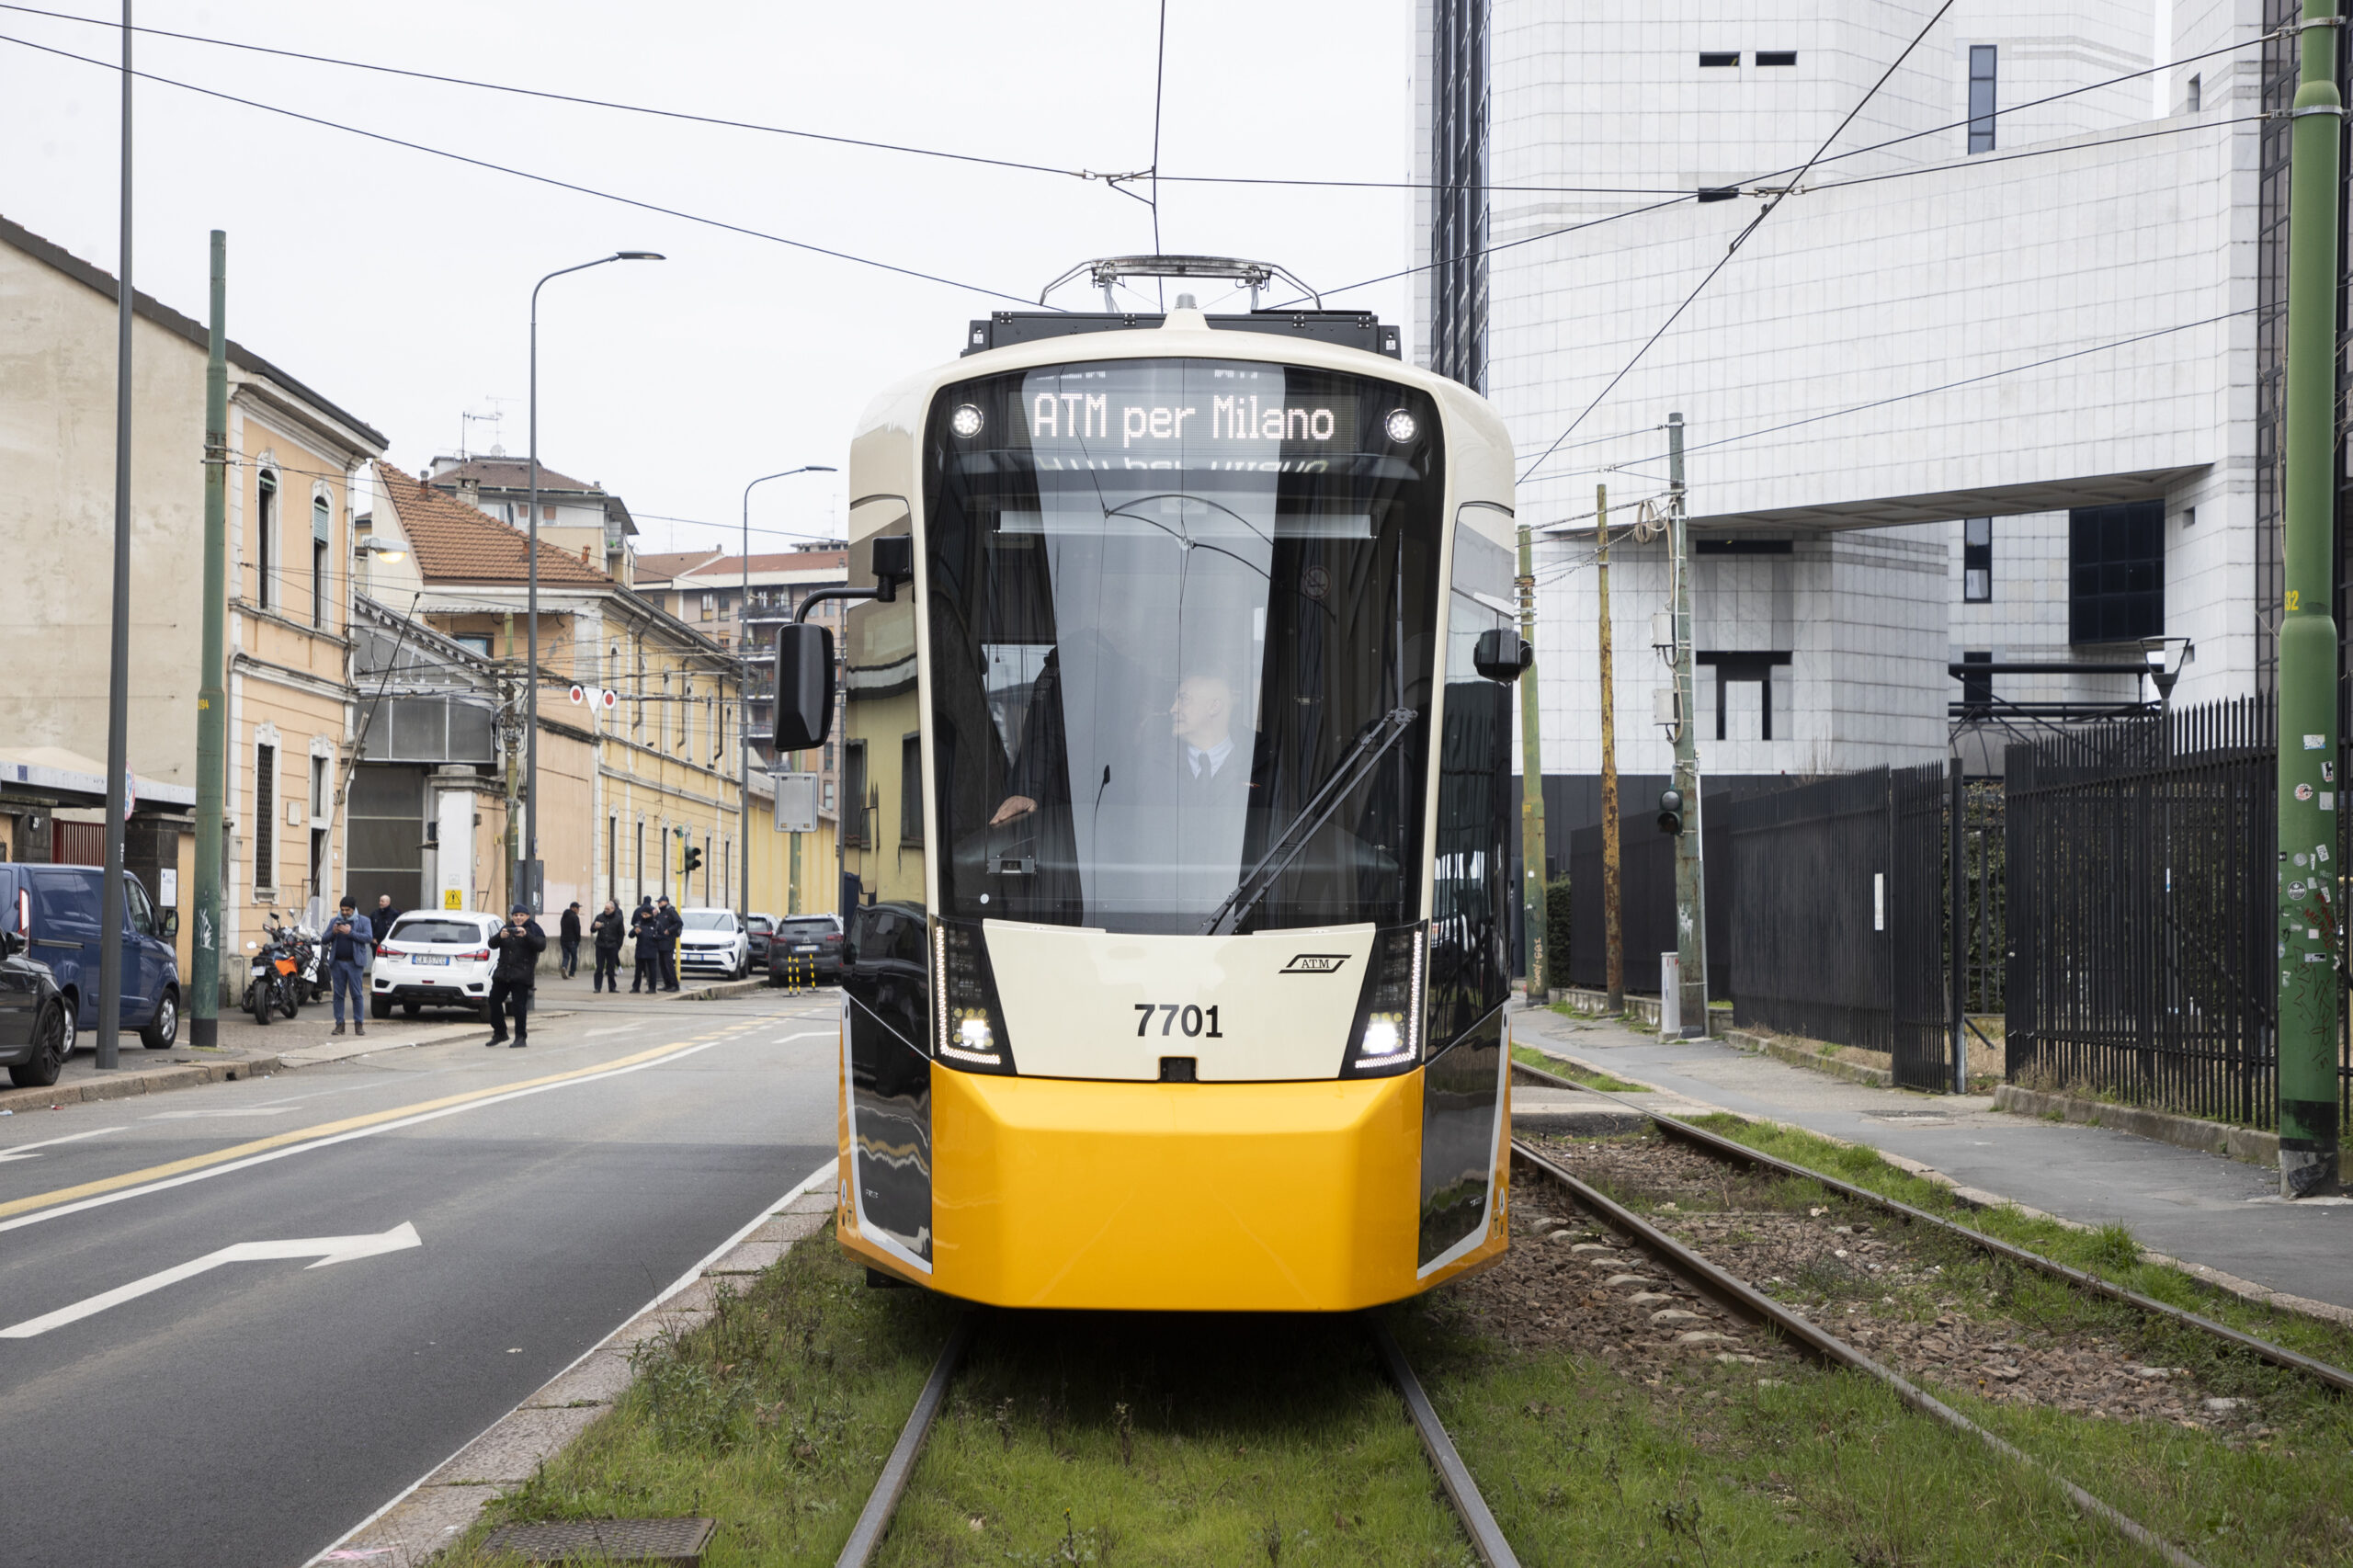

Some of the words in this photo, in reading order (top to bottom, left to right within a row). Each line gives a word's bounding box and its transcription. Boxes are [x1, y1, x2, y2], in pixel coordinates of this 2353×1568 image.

[1033, 392, 1108, 437] ATM
[1123, 406, 1196, 449] per
[1212, 394, 1336, 440] Milano
[1301, 959, 1330, 969] ATM
[1134, 1003, 1223, 1039] 7701
